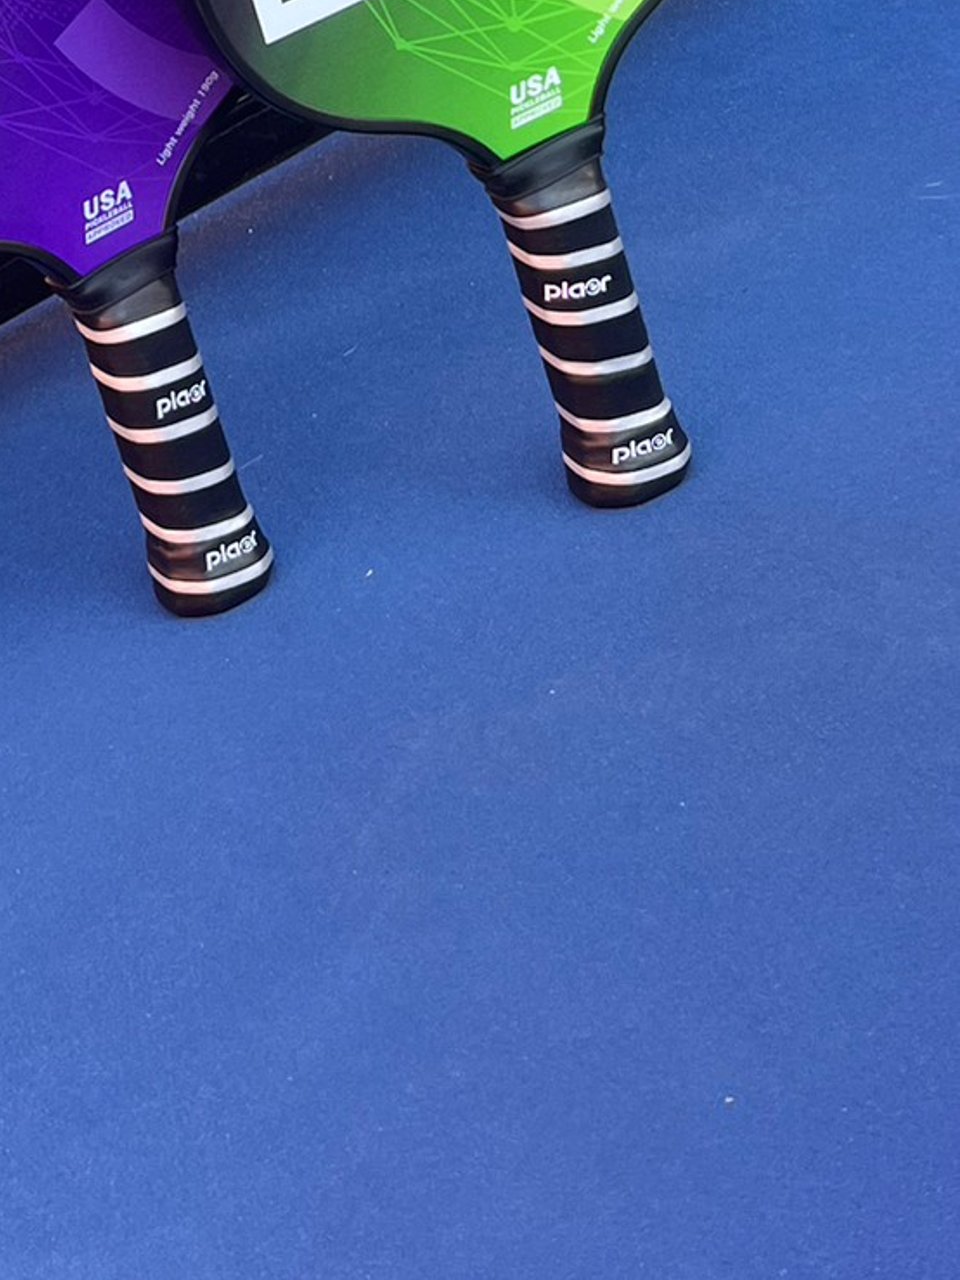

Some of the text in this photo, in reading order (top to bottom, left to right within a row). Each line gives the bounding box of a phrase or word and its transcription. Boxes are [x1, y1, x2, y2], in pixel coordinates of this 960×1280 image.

[587, 13, 612, 44] Light
[510, 65, 561, 105] USA
[155, 71, 219, 167] Light weight 190g
[83, 179, 133, 220] USA
